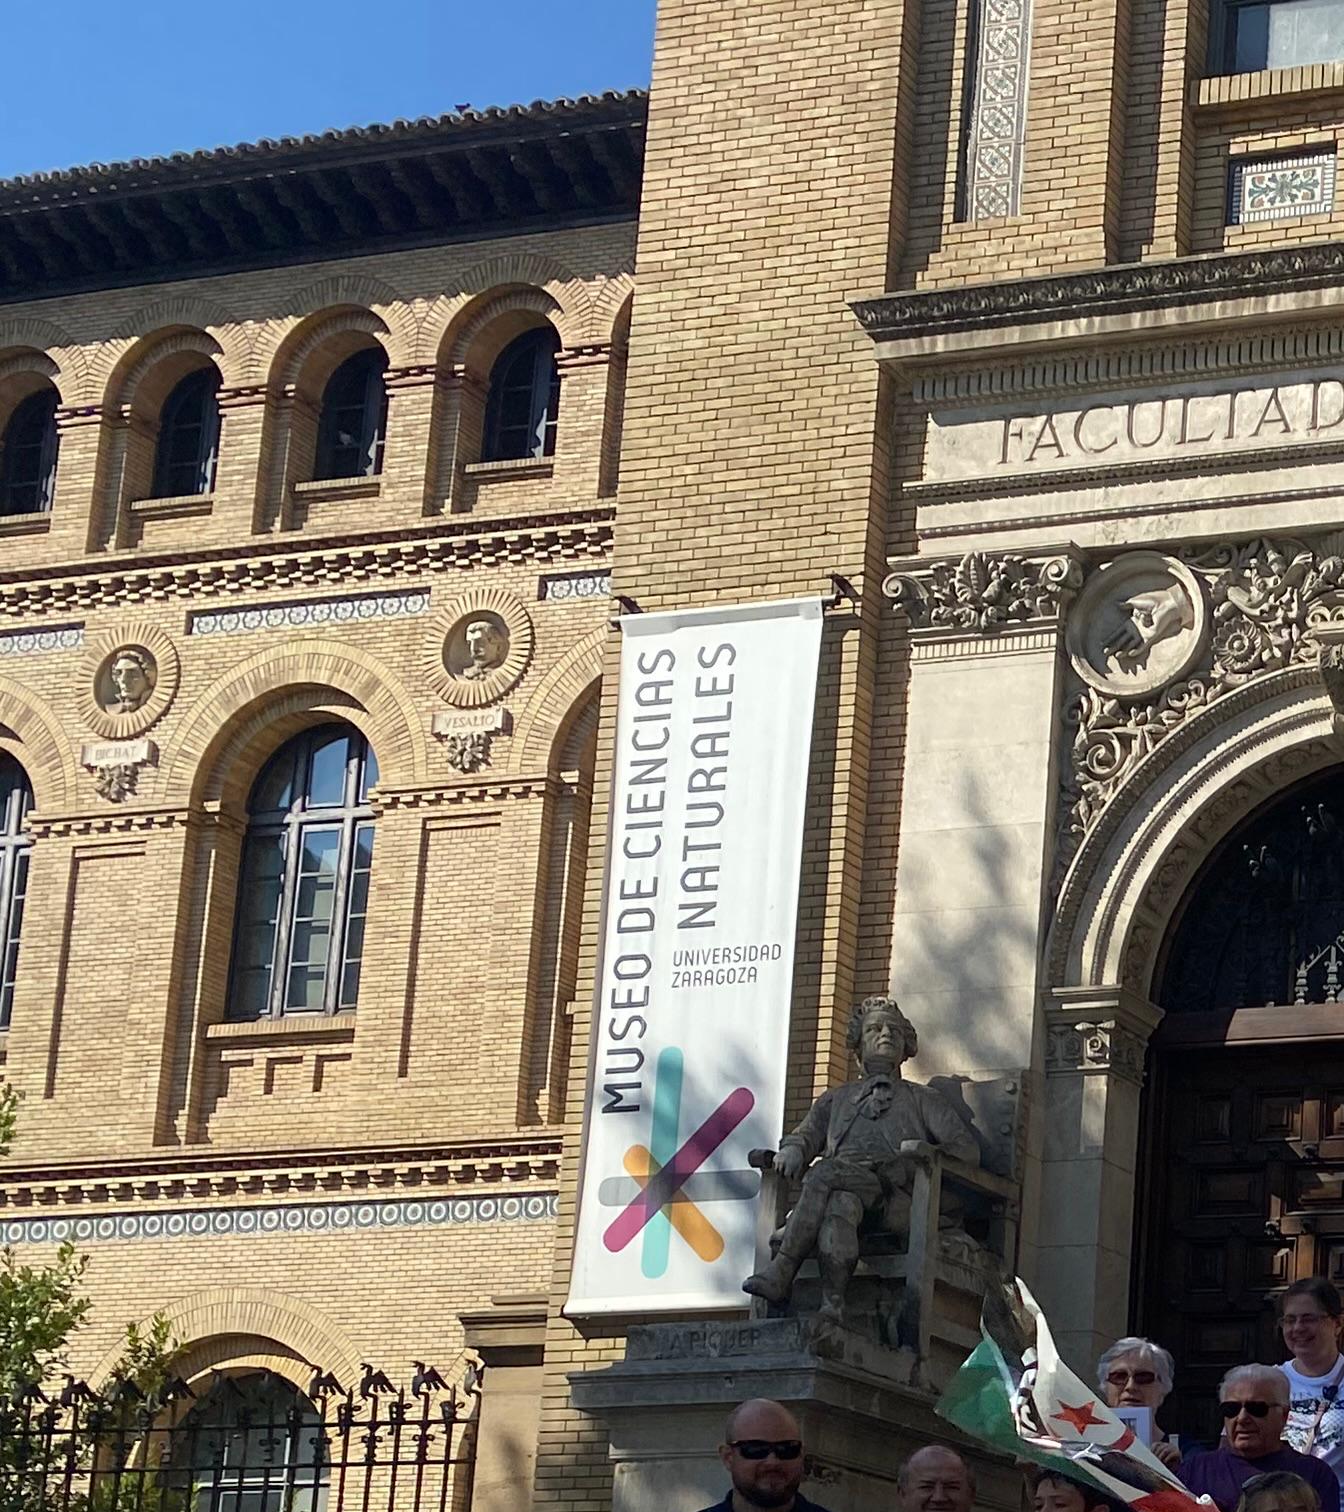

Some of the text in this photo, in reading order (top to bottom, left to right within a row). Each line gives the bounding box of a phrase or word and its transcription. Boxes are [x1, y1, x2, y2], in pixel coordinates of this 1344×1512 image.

[676, 642, 737, 930] NATURALES
[602, 648, 677, 1115] MUSEO DE CIENCIAS
[672, 944, 783, 968] UNIVERSIDAD
[670, 966, 758, 989] ZARAGOZA
